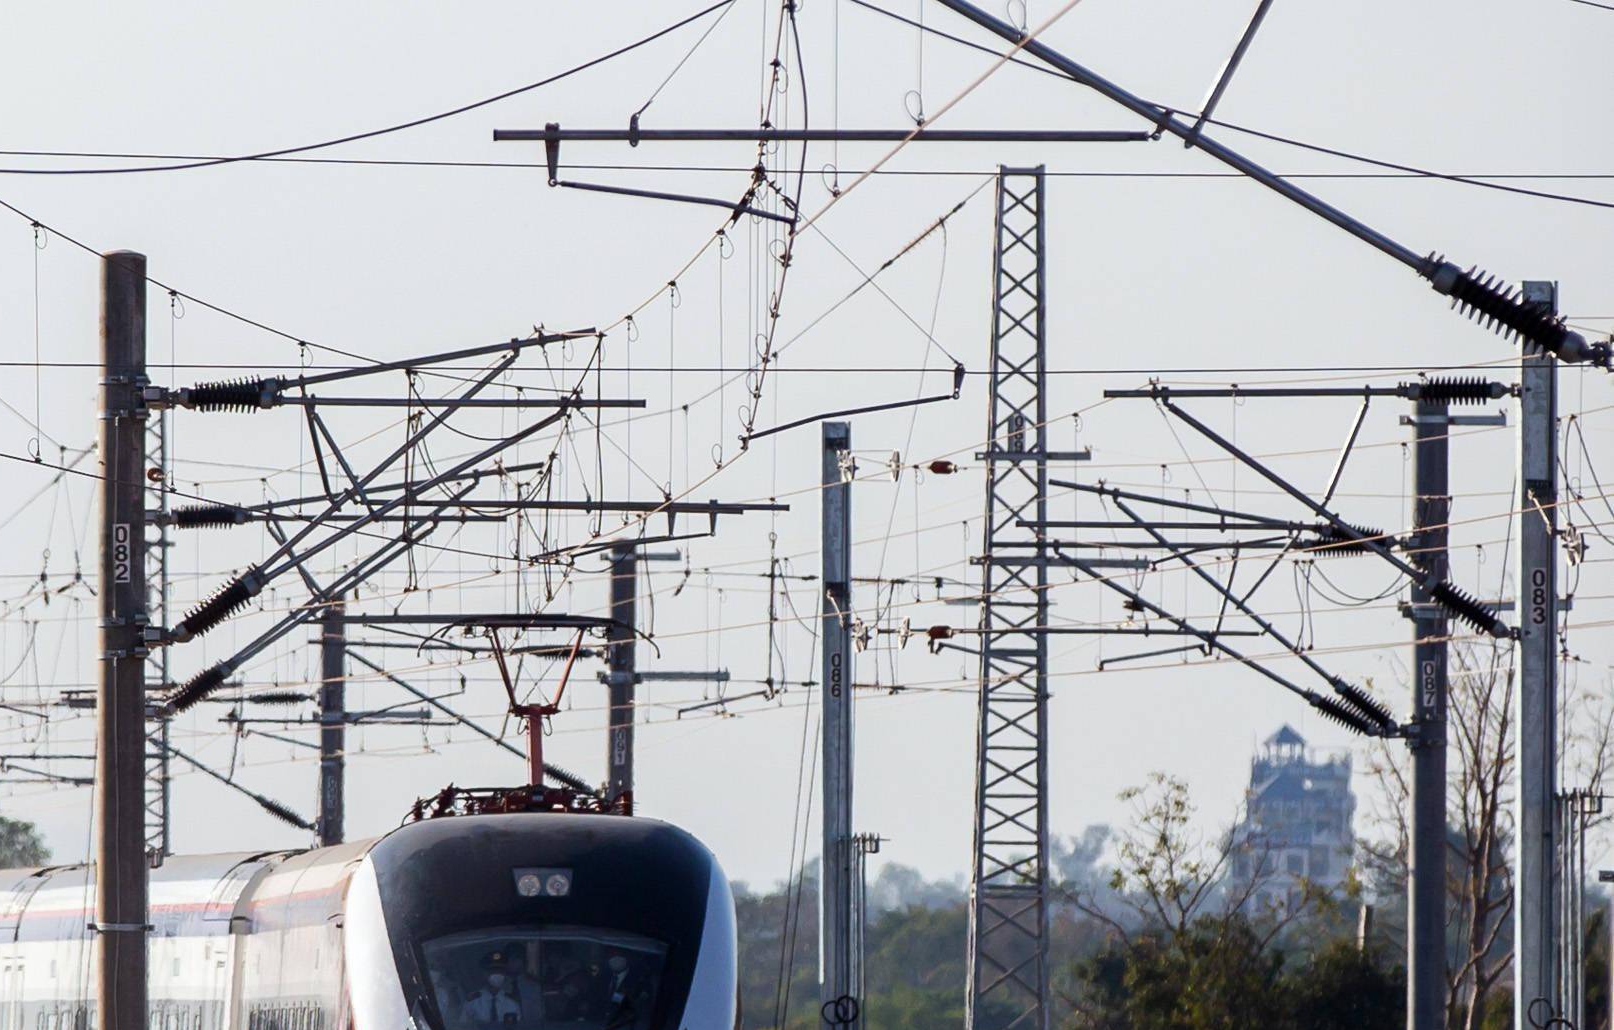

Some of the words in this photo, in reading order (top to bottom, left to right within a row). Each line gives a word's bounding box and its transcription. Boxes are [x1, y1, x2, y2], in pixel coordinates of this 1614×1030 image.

[115, 525, 129, 581] 082
[1531, 570, 1545, 624] 083
[831, 652, 841, 698] 086
[1424, 664, 1435, 705] 087
